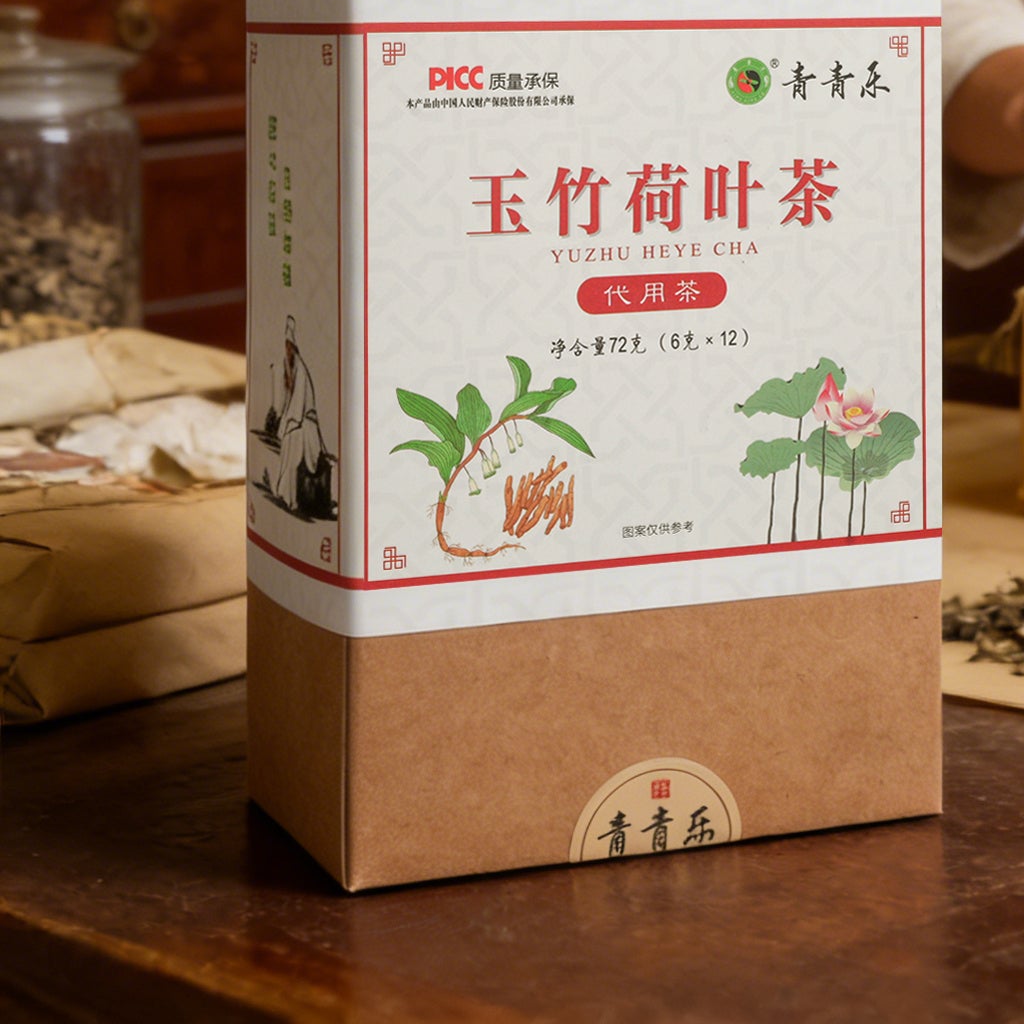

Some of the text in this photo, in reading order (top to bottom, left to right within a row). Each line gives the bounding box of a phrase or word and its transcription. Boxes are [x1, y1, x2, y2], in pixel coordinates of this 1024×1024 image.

[428, 65, 560, 91] PICC 质量承保
[782, 60, 891, 101] 青青乐
[467, 158, 840, 238] 玉竹荷叶茶
[551, 241, 760, 264] YUZHU HEYE CHA
[603, 280, 701, 307] 代用茶
[622, 520, 694, 539] 图案仅供参考
